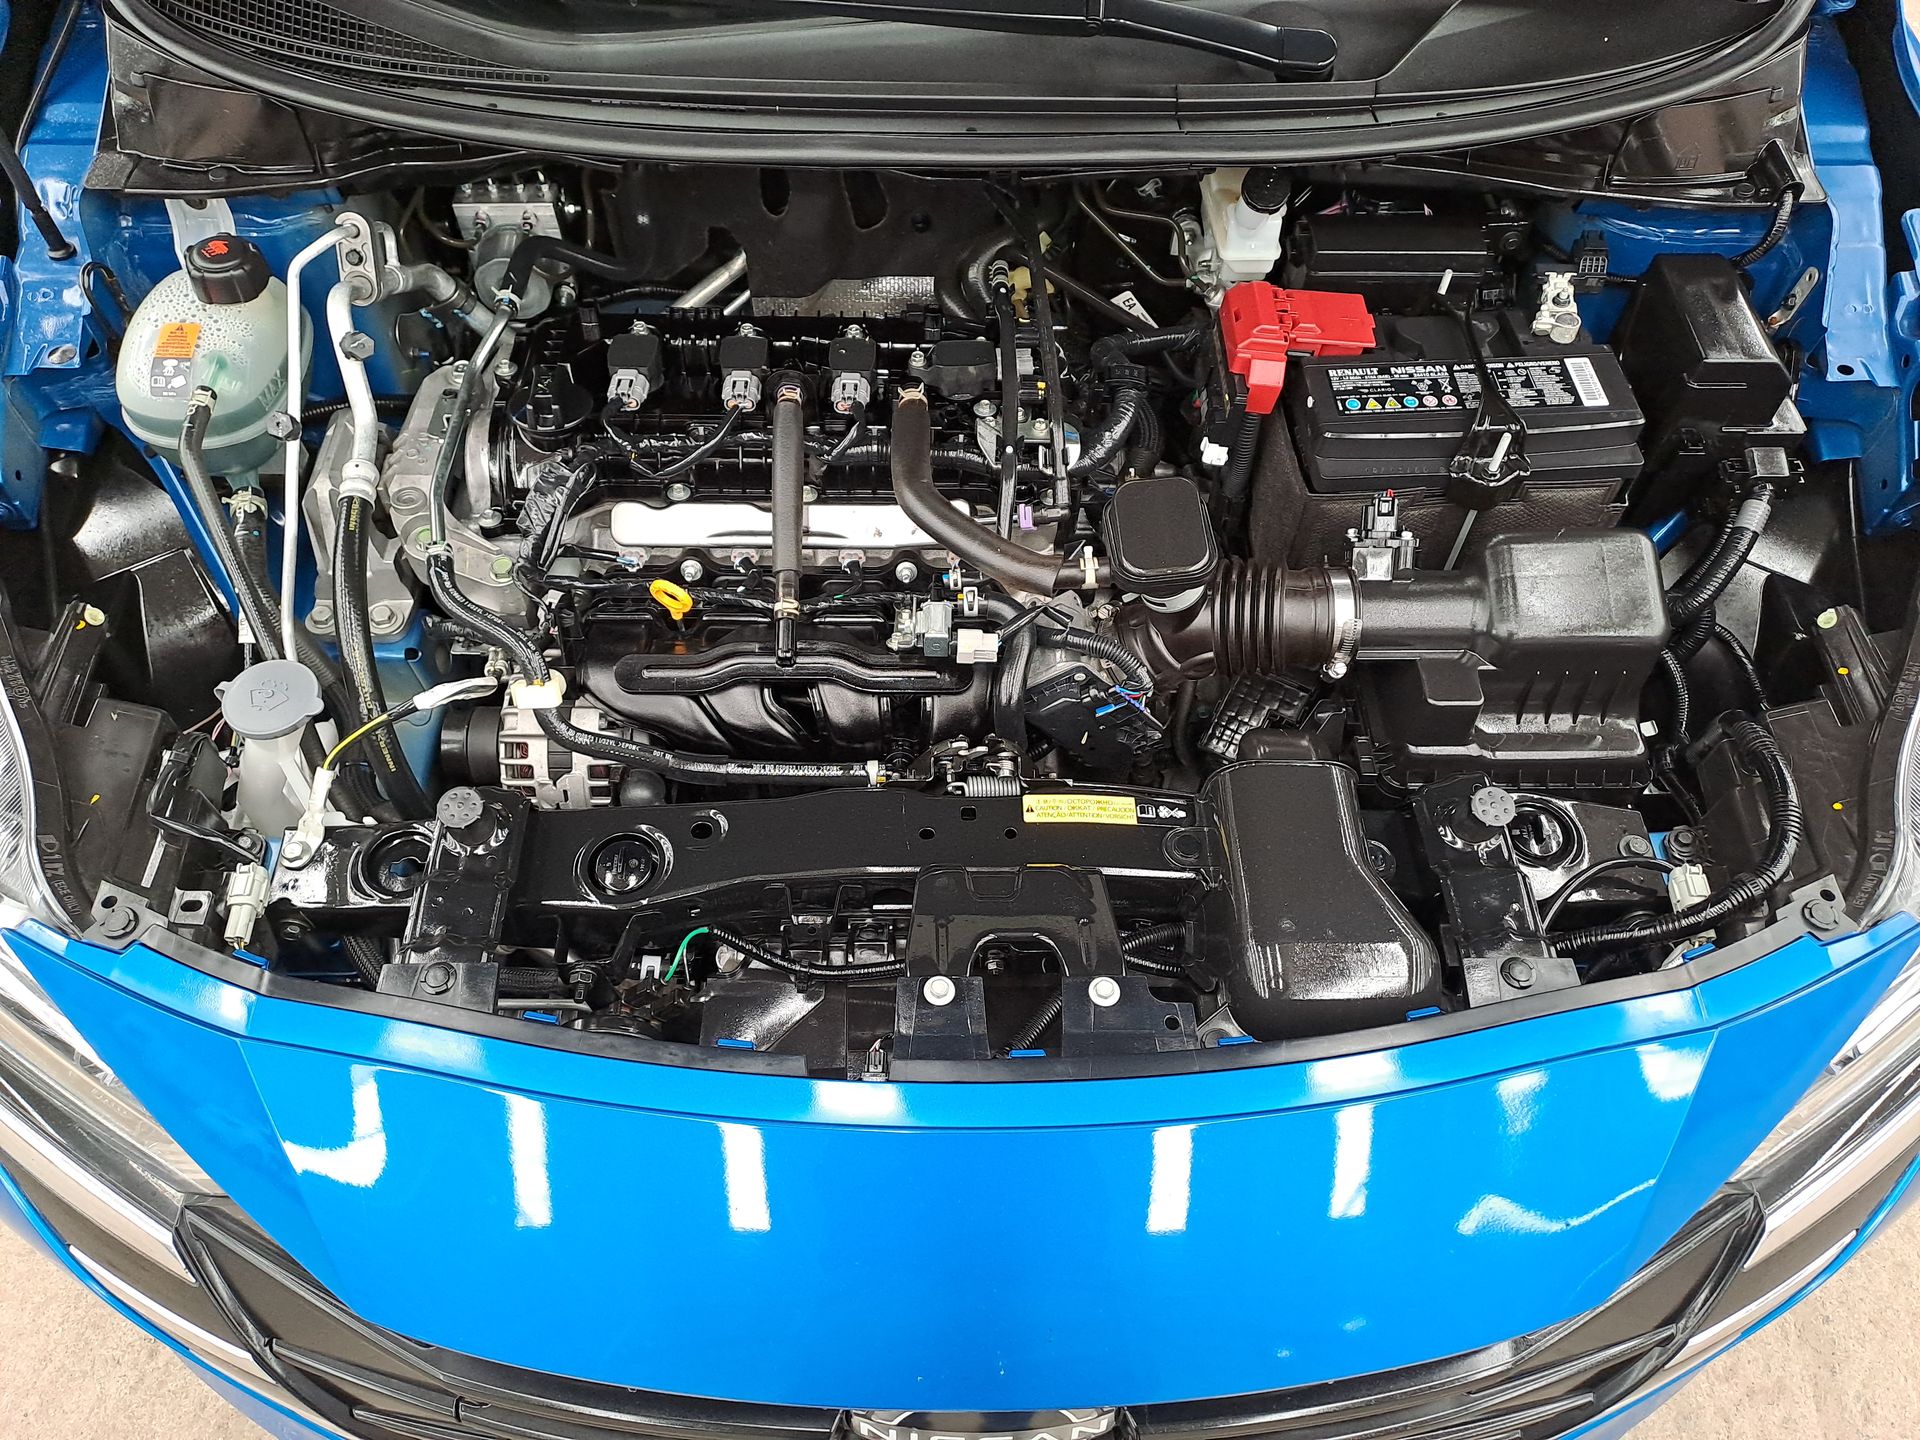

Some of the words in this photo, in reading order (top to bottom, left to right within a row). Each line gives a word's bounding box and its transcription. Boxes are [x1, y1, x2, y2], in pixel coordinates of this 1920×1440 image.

[1122, 297, 1137, 311] EA
[1328, 368, 1379, 376] RENAULT
[1390, 365, 1448, 375] NISSAN
